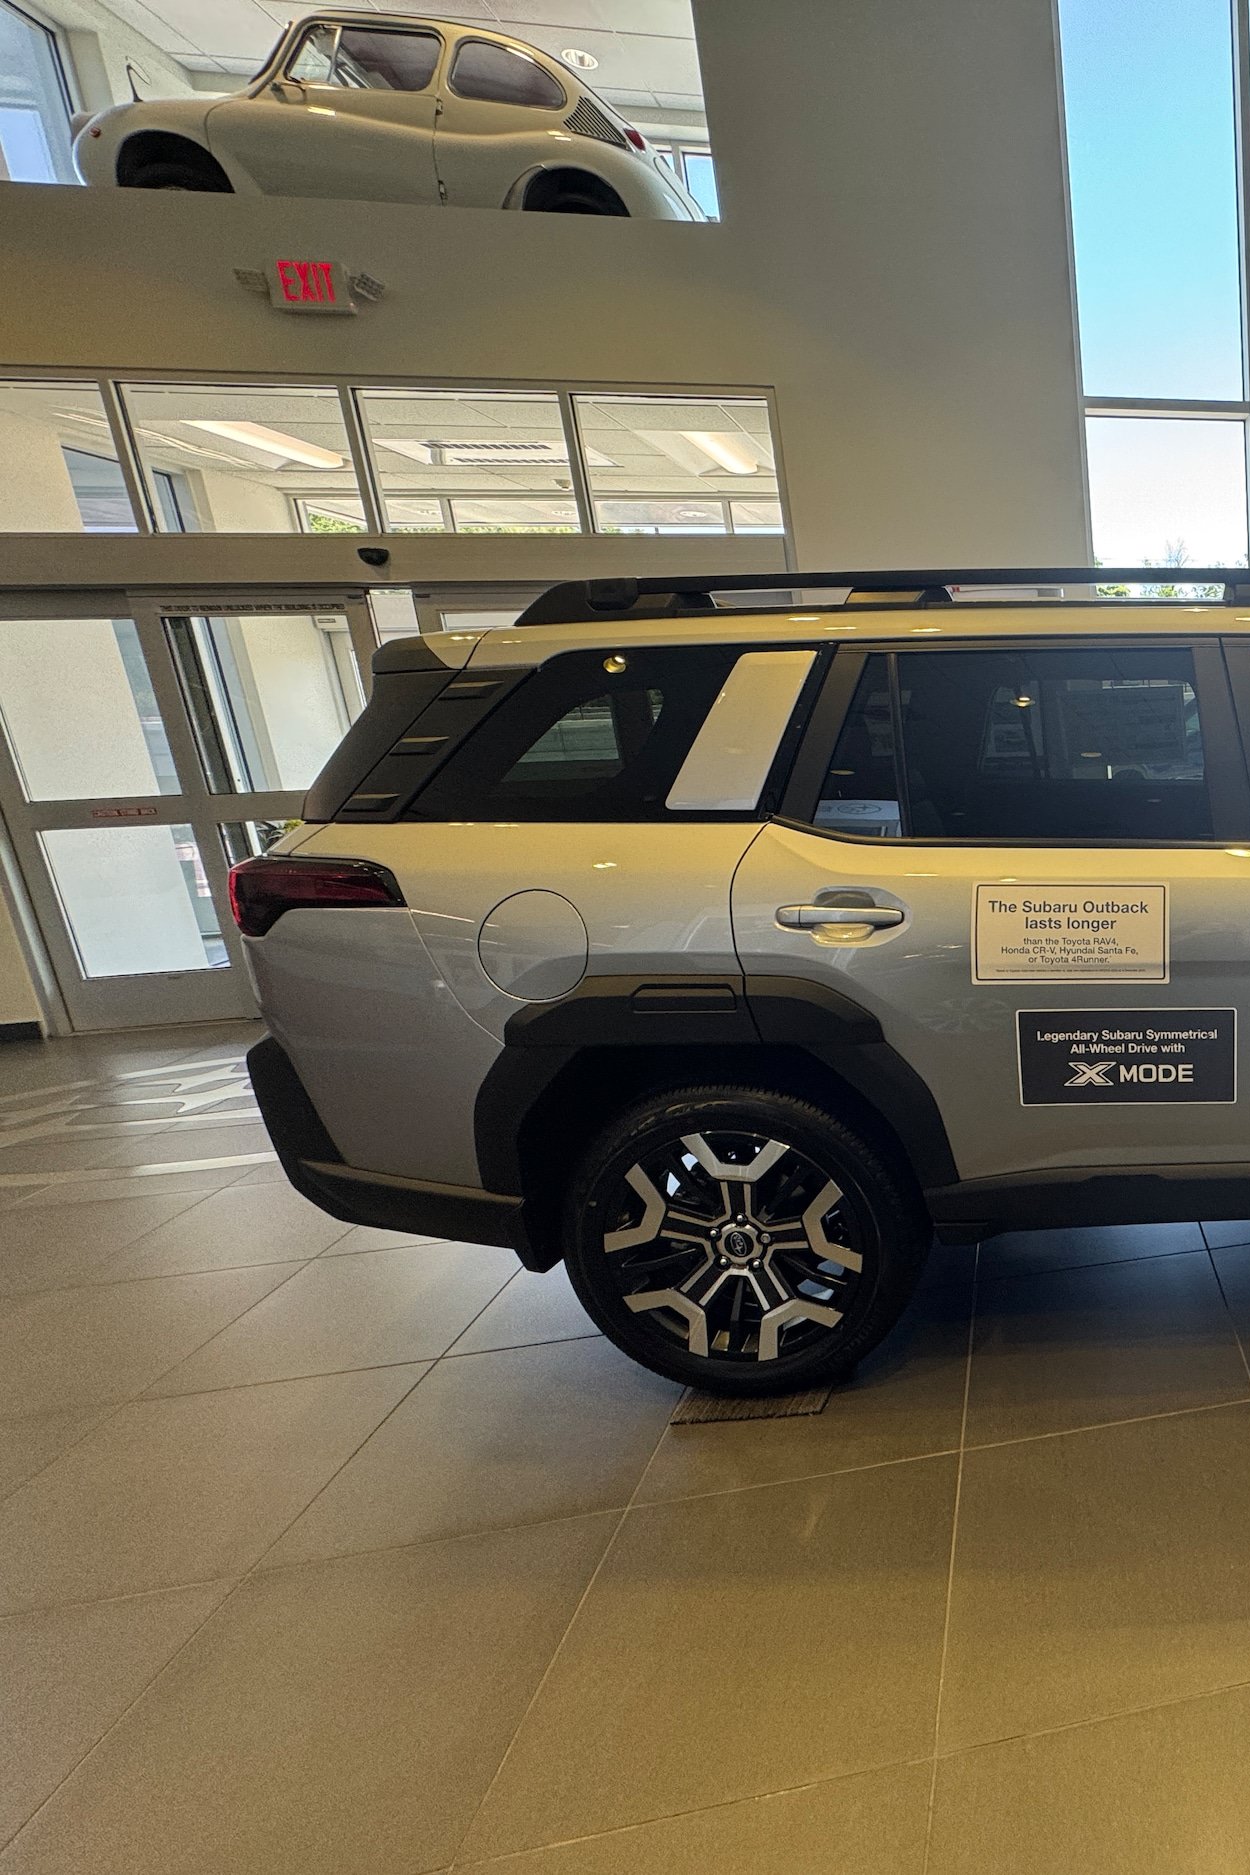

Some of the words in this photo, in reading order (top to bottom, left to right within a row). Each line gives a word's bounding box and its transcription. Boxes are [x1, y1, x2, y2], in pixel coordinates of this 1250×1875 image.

[276, 260, 337, 303] EXIT
[988, 900, 1018, 914] The
[1022, 900, 1078, 914] Subaru
[1082, 901, 1149, 914] Outback
[1025, 917, 1062, 930] lasts
[1066, 917, 1117, 932] longer
[1023, 937, 1043, 946] than
[1045, 937, 1060, 946] the
[1061, 937, 1092, 948] Toyota
[1093, 938, 1120, 948] RAV4,
[1001, 947, 1030, 955] Honda
[1032, 947, 1058, 956] CR-V,
[1059, 947, 1096, 957] Hyundai
[1097, 947, 1123, 955] Santa
[1125, 947, 1139, 957] Fe,
[1040, 956, 1070, 966] Toyota
[1037, 1030, 1099, 1043] Legendary
[1101, 1030, 1144, 1041] Subaru
[1146, 1029, 1219, 1041] Symmetrical
[1070, 1043, 1126, 1055] All-Wheel
[1128, 1043, 1159, 1054] Drive
[1161, 1043, 1186, 1054] with
[1119, 1064, 1195, 1084] MODE
